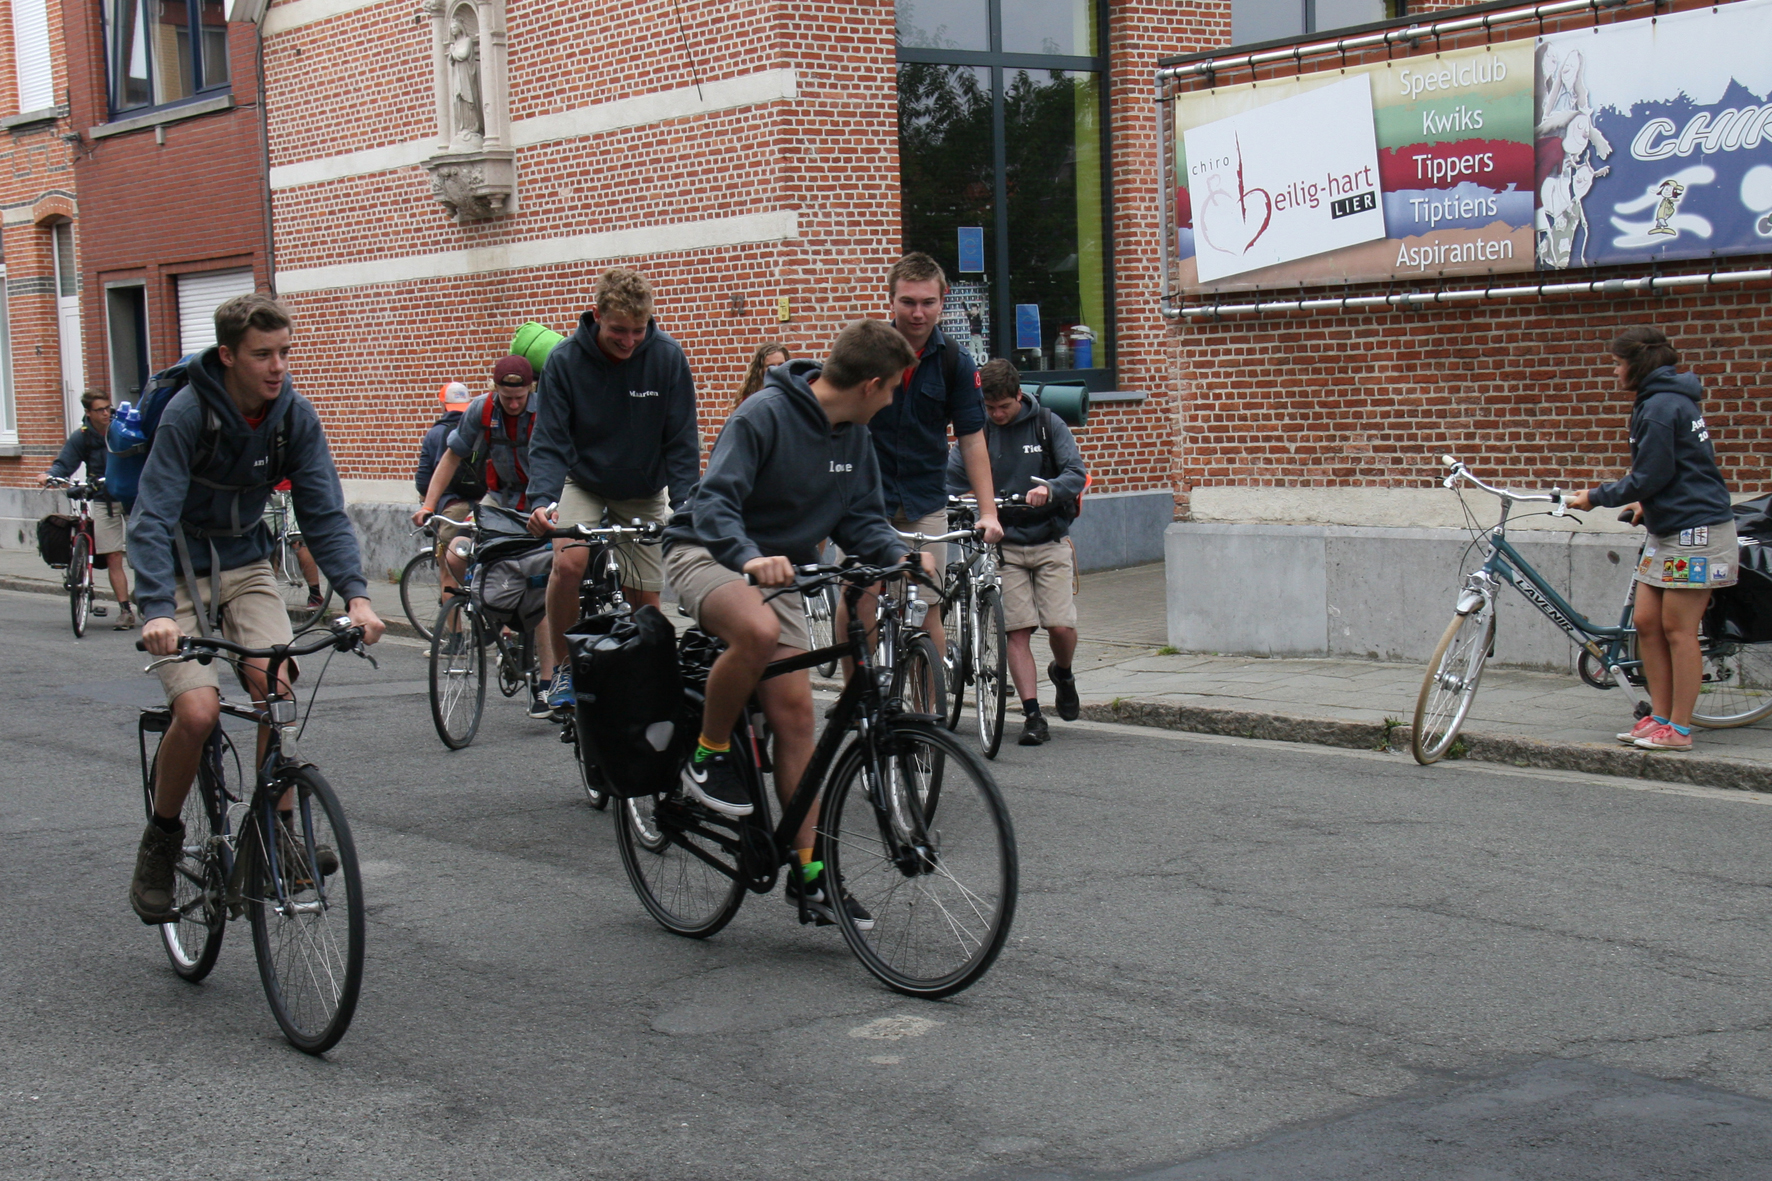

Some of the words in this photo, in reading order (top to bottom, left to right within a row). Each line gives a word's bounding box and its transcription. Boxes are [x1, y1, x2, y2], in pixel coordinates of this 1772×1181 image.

[1400, 56, 1507, 100] Speelclub
[1423, 105, 1483, 135] Kwiks
[1192, 156, 1230, 176] chiro
[1412, 151, 1494, 183] Tippers
[1333, 194, 1375, 216] LIER
[1409, 194, 1498, 228] Tiptiens
[1396, 237, 1513, 271] Aspiranten
[1515, 579, 1575, 632] L'AVENIR
